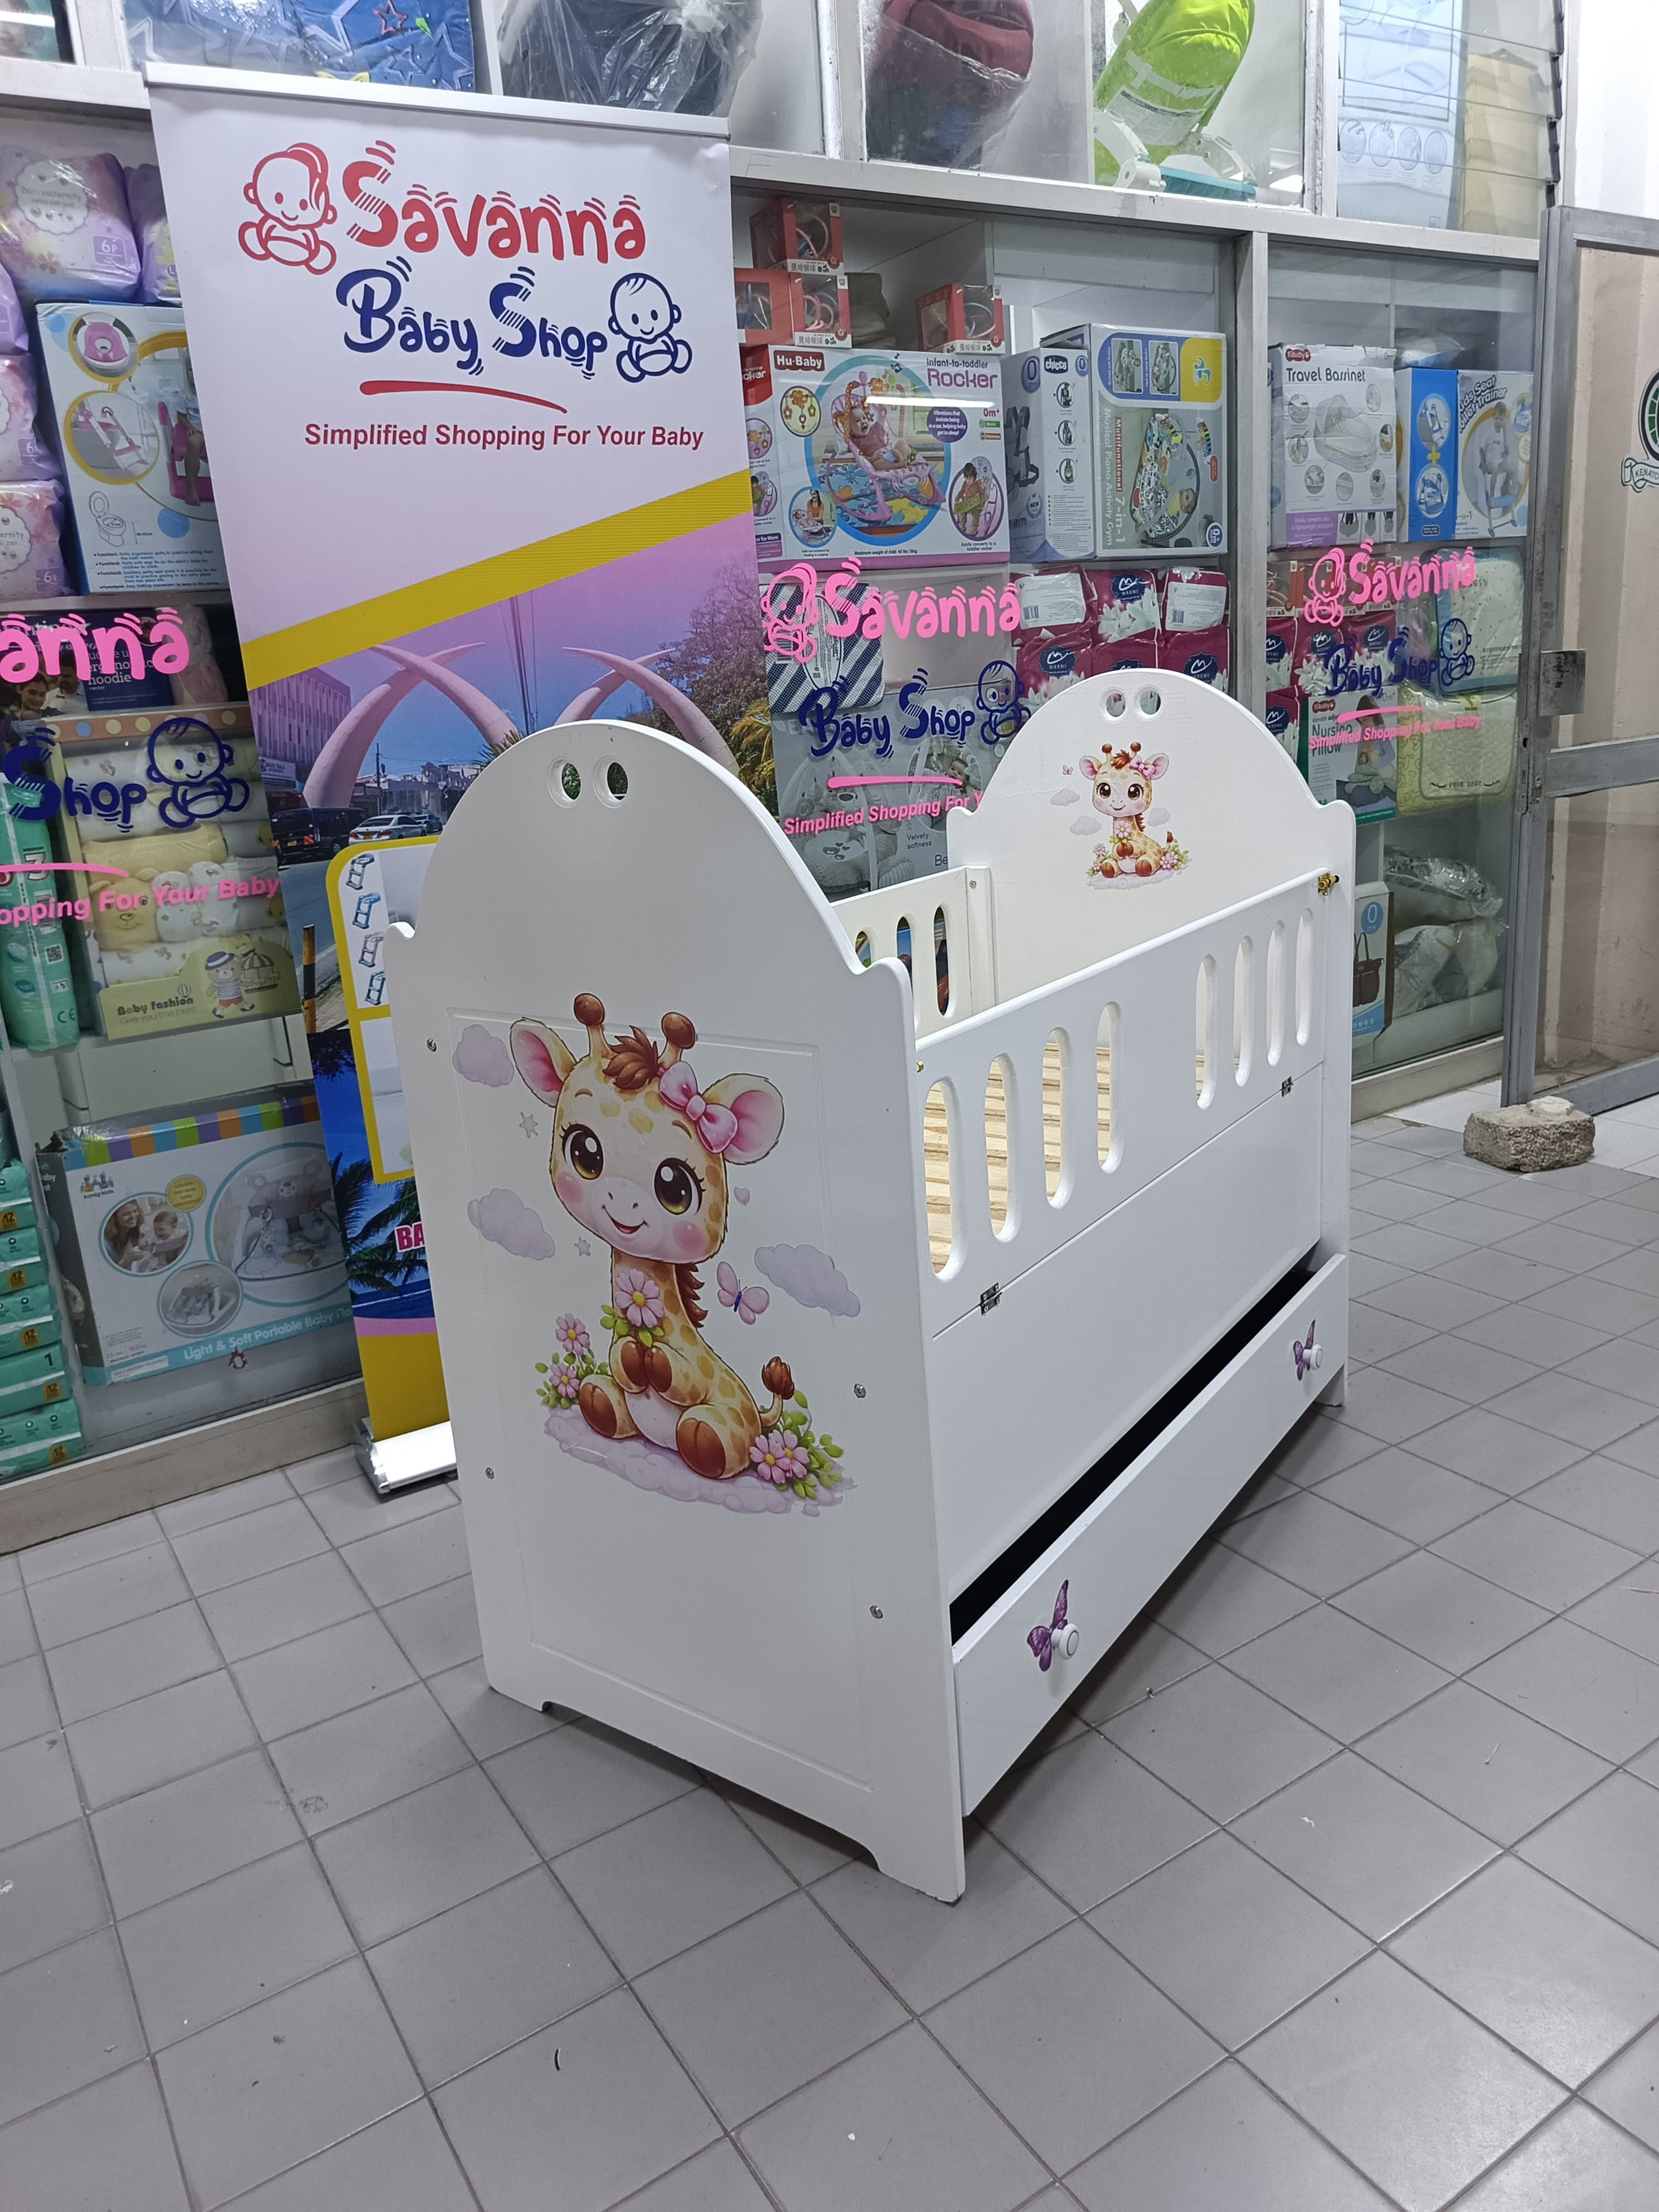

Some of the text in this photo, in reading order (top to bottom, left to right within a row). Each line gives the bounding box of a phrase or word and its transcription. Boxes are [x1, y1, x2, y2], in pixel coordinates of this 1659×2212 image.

[342, 160, 647, 264] Savanna
[335, 268, 608, 372] Baby Shop
[926, 357, 989, 369] Infant-to-toddler
[926, 368, 998, 389] Rocker
[1045, 357, 1068, 371] chicco
[1286, 367, 1366, 382] Travel Bassinet
[1475, 387, 1507, 409] Trainer
[304, 424, 704, 450] Simplified Shopping For Your Baby
[1105, 482, 1114, 517] Activity
[1348, 551, 1476, 605] Savanna
[824, 573, 1020, 639] Savanna
[798, 682, 976, 757] Baby Shop
[3, 744, 148, 824] Shop
[783, 805, 864, 835] Simplified
[869, 800, 941, 823] Shopping
[906, 832, 929, 842] Velvety
[907, 839, 933, 850] softness
[24, 851, 51, 881] 3
[0, 875, 281, 928] opping For Your Baby
[183, 1344, 214, 1361] Light
[216, 1340, 226, 1351] &
[229, 1335, 252, 1349] Soft
[254, 1320, 303, 1346] Portable
[305, 1310, 334, 1328] Baby
[44, 1352, 54, 1366] 1
